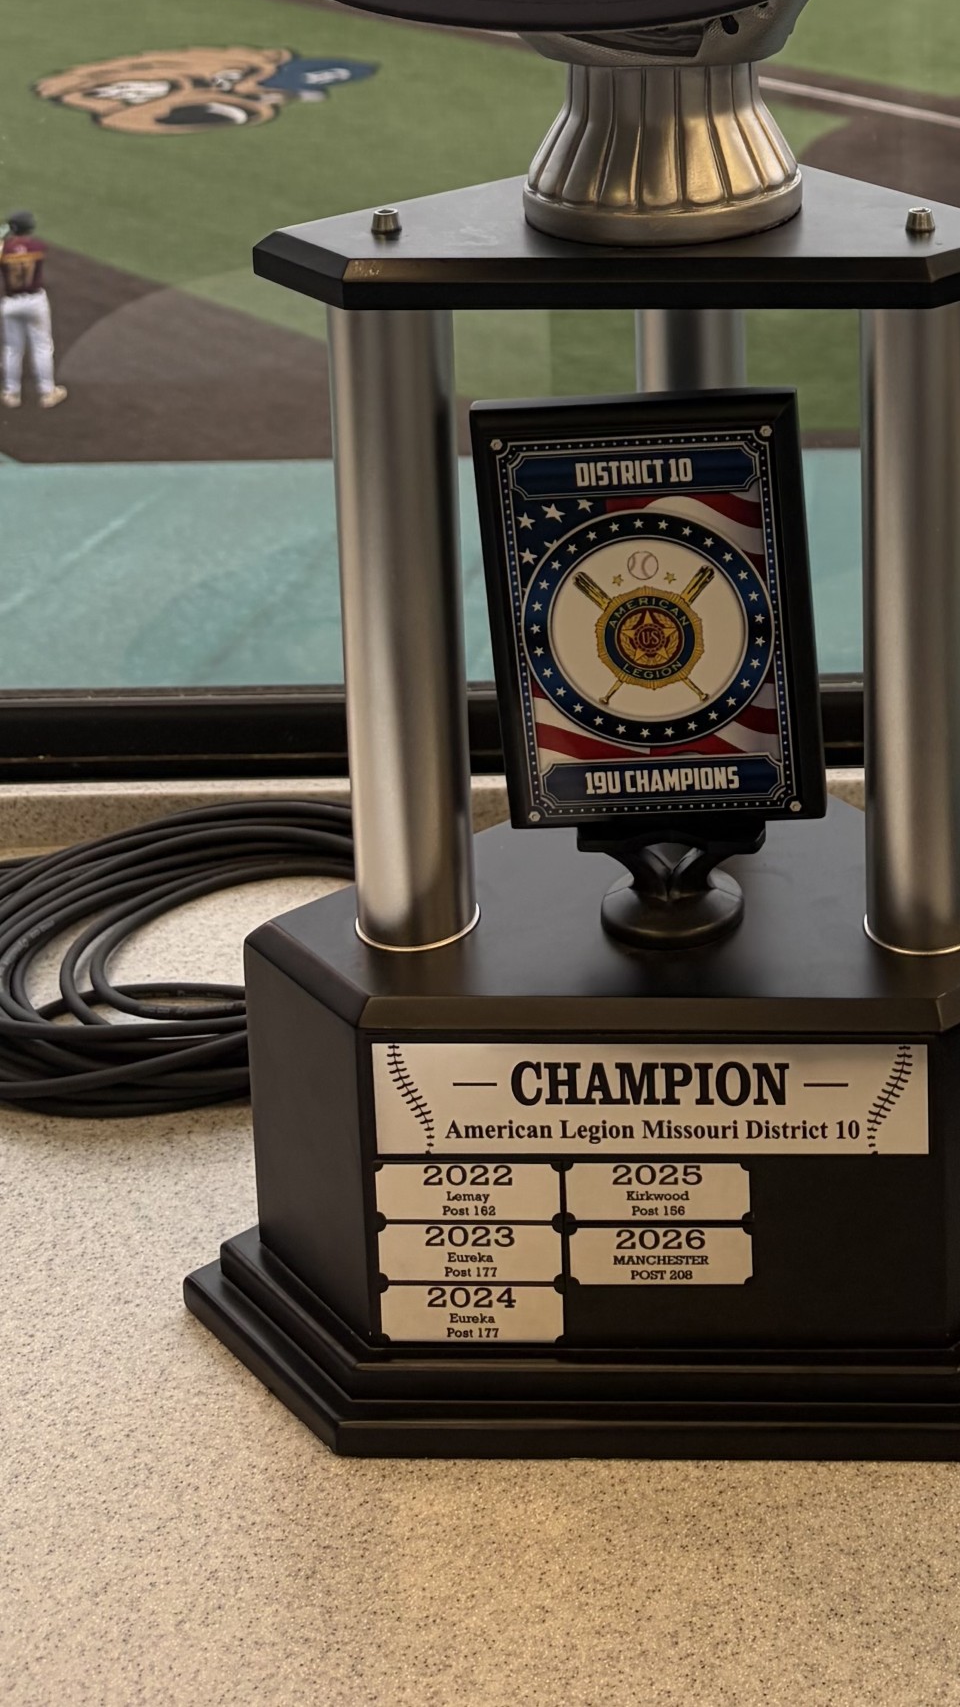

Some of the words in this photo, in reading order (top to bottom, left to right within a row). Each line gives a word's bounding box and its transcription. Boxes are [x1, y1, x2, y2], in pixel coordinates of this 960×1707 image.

[574, 459, 664, 488] DISTRICT
[668, 457, 694, 484] 10
[608, 597, 690, 629] AMERICAN
[622, 660, 683, 679] LEGION
[584, 769, 621, 795] 19U
[624, 765, 740, 794] CHAMPIONS
[510, 1060, 790, 1106] CHAMPION
[444, 1119, 553, 1141] American
[560, 1119, 637, 1145] Legion
[642, 1119, 739, 1141] Missouri
[745, 1119, 831, 1142] District
[836, 1120, 861, 1141] 10
[423, 1165, 513, 1186] 2022
[612, 1164, 703, 1186] 2025
[446, 1191, 490, 1203] Lemay
[626, 1190, 690, 1201] Kirkwood
[442, 1205, 470, 1216] Post
[474, 1205, 497, 1216] 162
[631, 1205, 659, 1216] Post
[663, 1205, 686, 1216] 156
[425, 1225, 516, 1248] 2023
[615, 1229, 706, 1250] 2026
[447, 1251, 494, 1263] Eureka
[612, 1255, 710, 1266] MANCHESTER
[444, 1266, 472, 1277] Post
[476, 1266, 498, 1277] 177
[630, 1270, 667, 1281] POST
[669, 1270, 693, 1280] 208
[427, 1286, 517, 1309] 2024
[449, 1312, 496, 1324] Eureka
[446, 1327, 473, 1338] Post
[478, 1327, 500, 1338] 177
